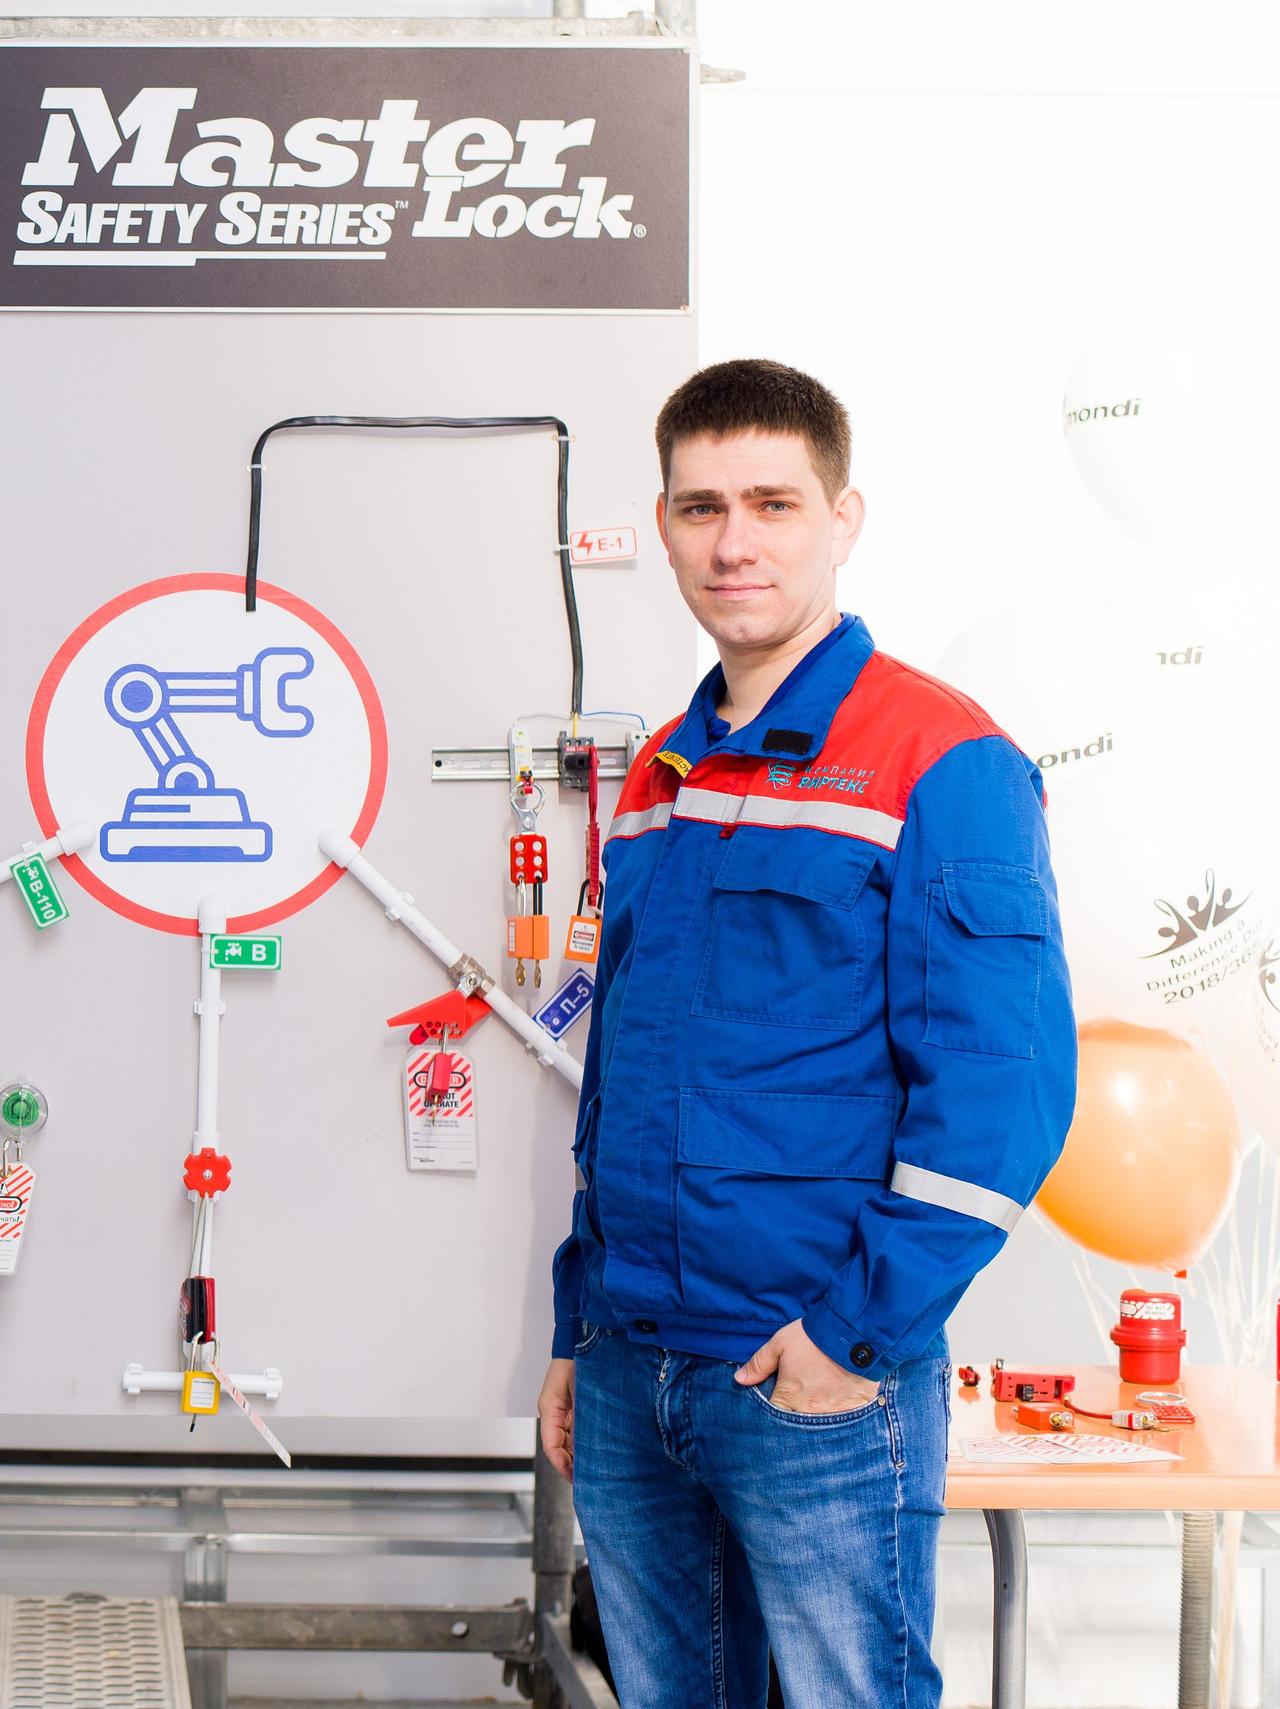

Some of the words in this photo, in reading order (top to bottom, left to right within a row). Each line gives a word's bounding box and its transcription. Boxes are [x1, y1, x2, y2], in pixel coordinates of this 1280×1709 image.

[20, 87, 597, 188] Master
[16, 191, 208, 245] SAFETY
[1036, 732, 1114, 770] ondi
[797, 777, 869, 794] ВИРТЕКС
[805, 766, 875, 778] КОМПАНИЯ
[1146, 944, 1239, 991] Difference
[1170, 930, 1232, 968] Making
